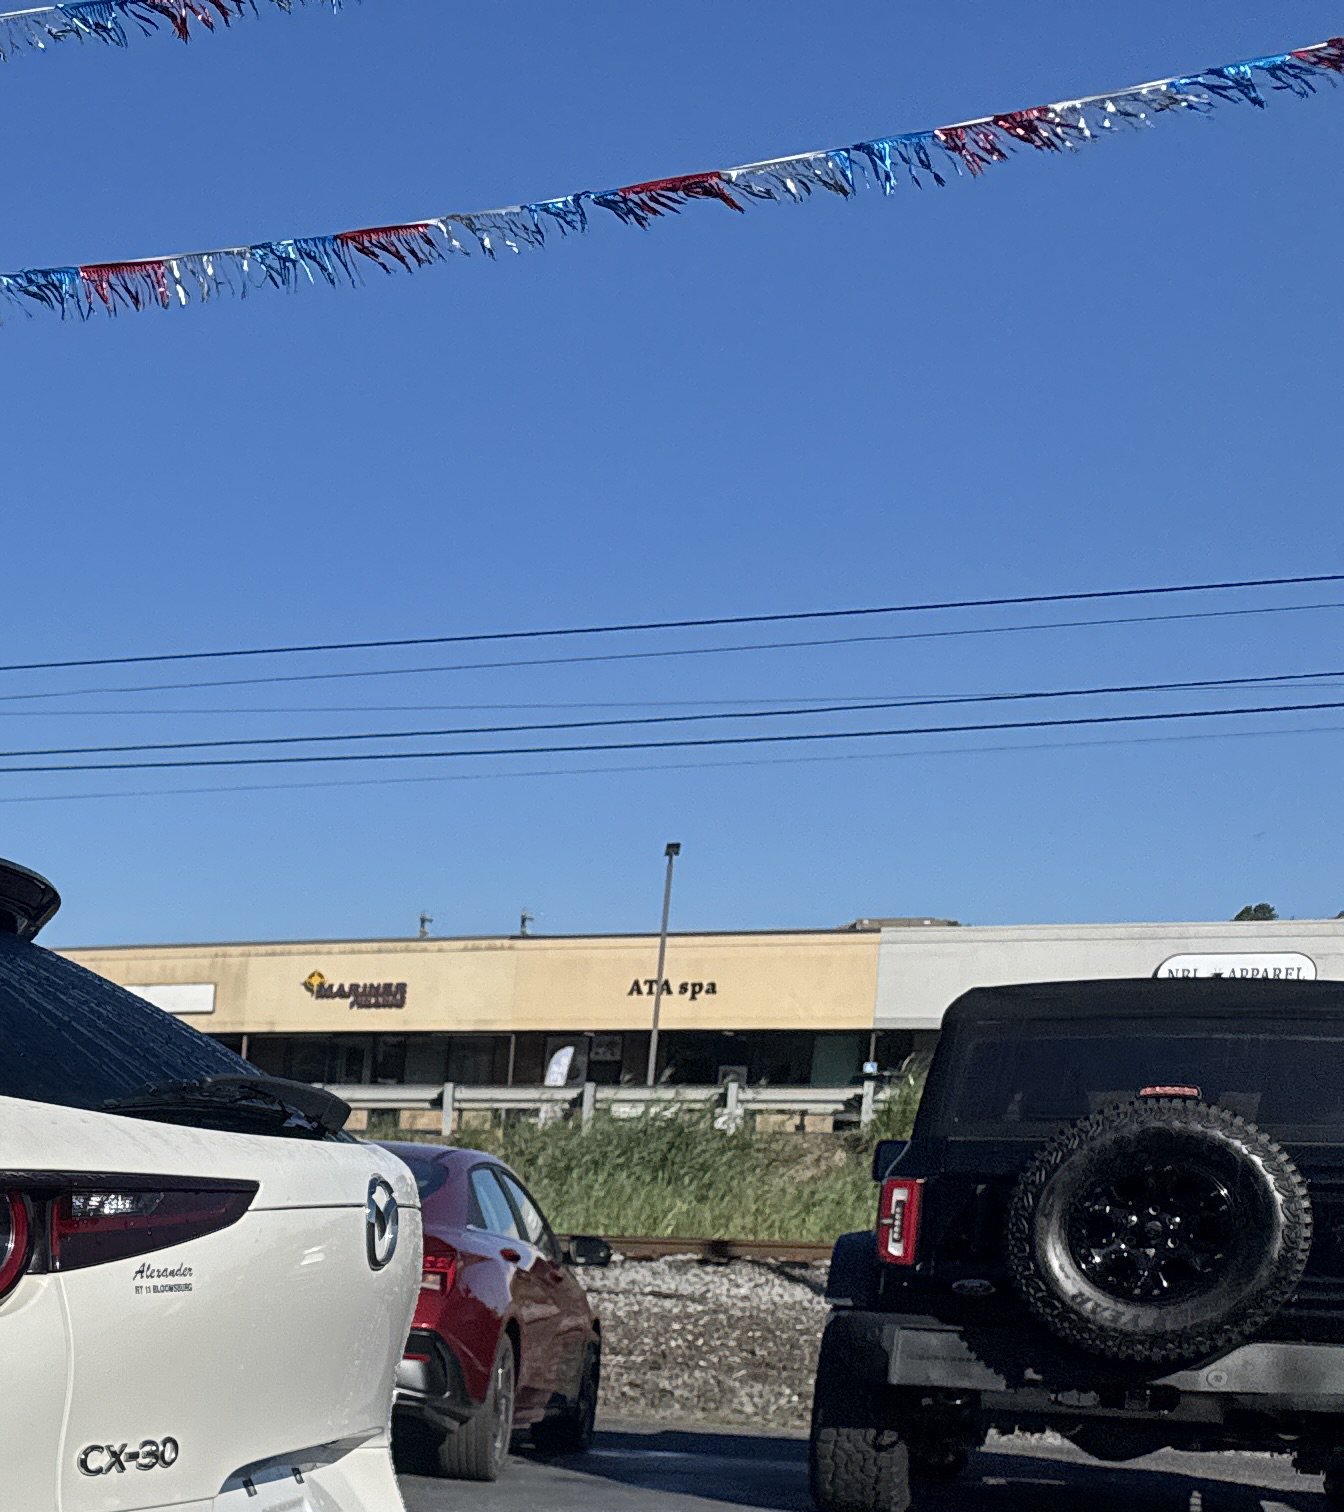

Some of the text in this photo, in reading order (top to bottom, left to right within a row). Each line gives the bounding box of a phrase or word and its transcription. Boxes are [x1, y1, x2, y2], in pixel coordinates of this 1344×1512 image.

[627, 979, 717, 1001] ATA spa
[133, 1262, 193, 1281] Alexander
[77, 1436, 179, 1477] CX-30
